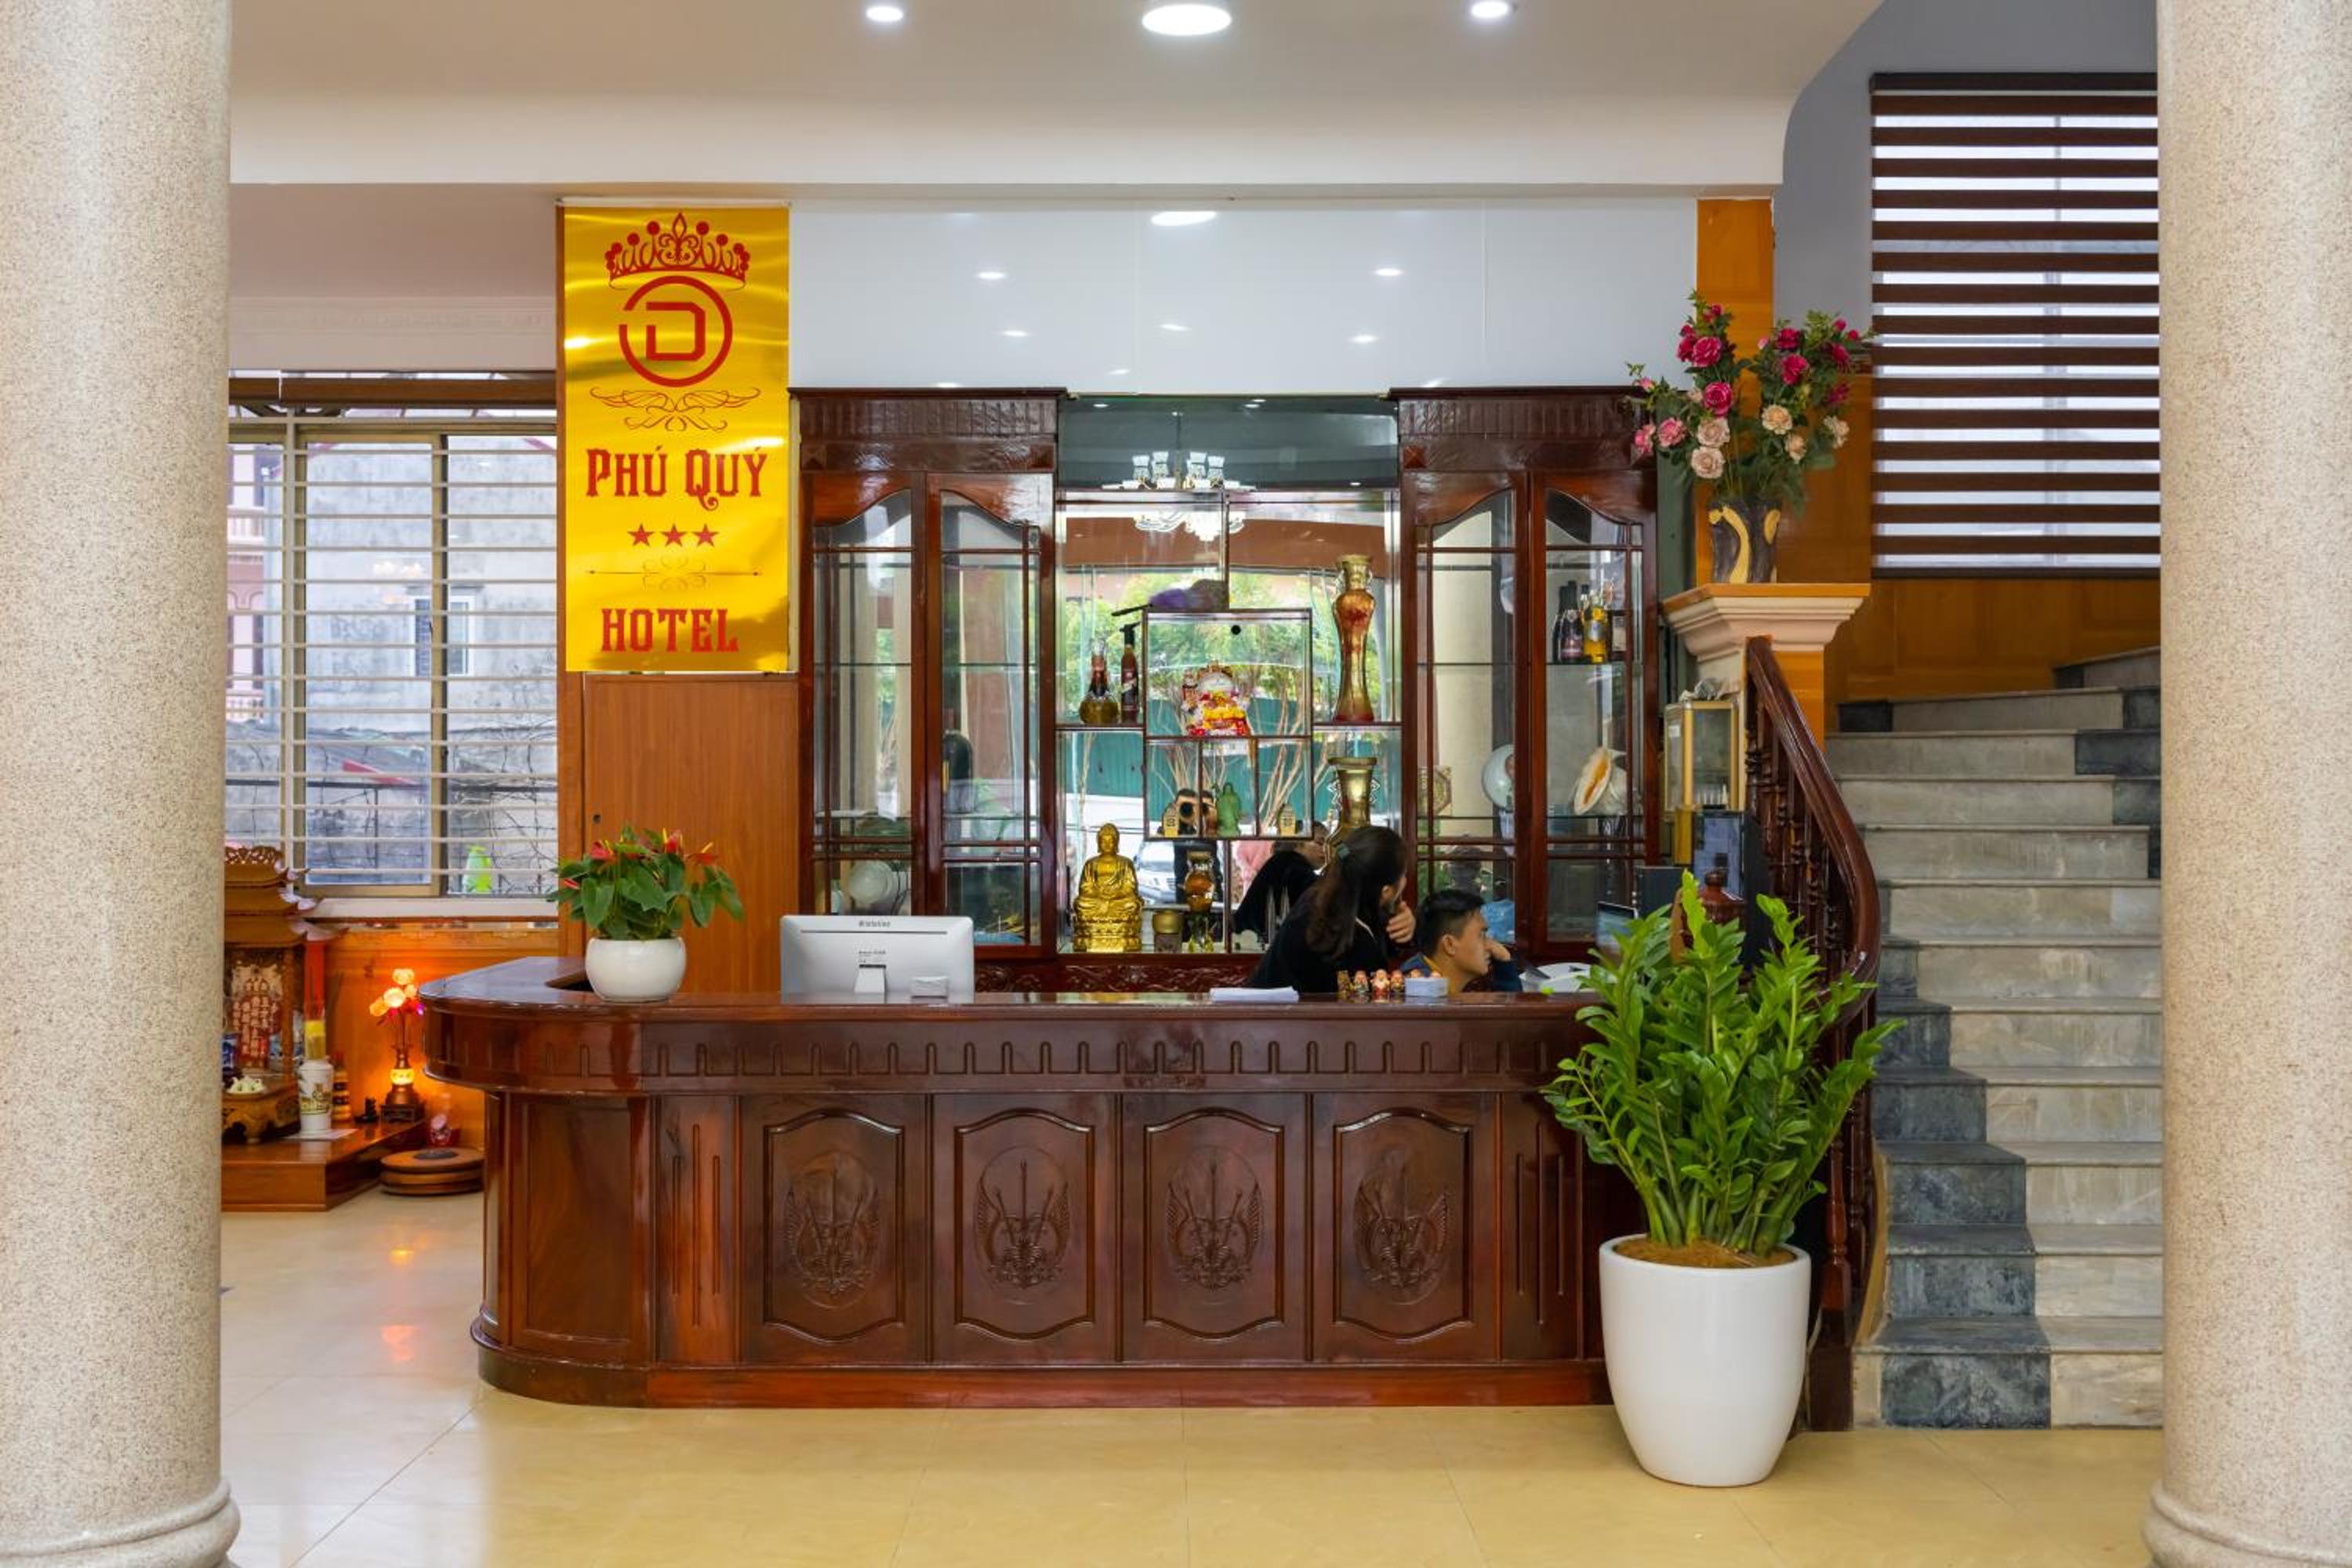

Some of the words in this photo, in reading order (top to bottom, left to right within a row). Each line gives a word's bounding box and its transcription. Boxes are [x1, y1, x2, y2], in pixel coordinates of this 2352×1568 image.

[586, 445, 667, 497] PHÚ
[684, 445, 768, 510] QUÝ
[601, 608, 741, 654] HOTEL
